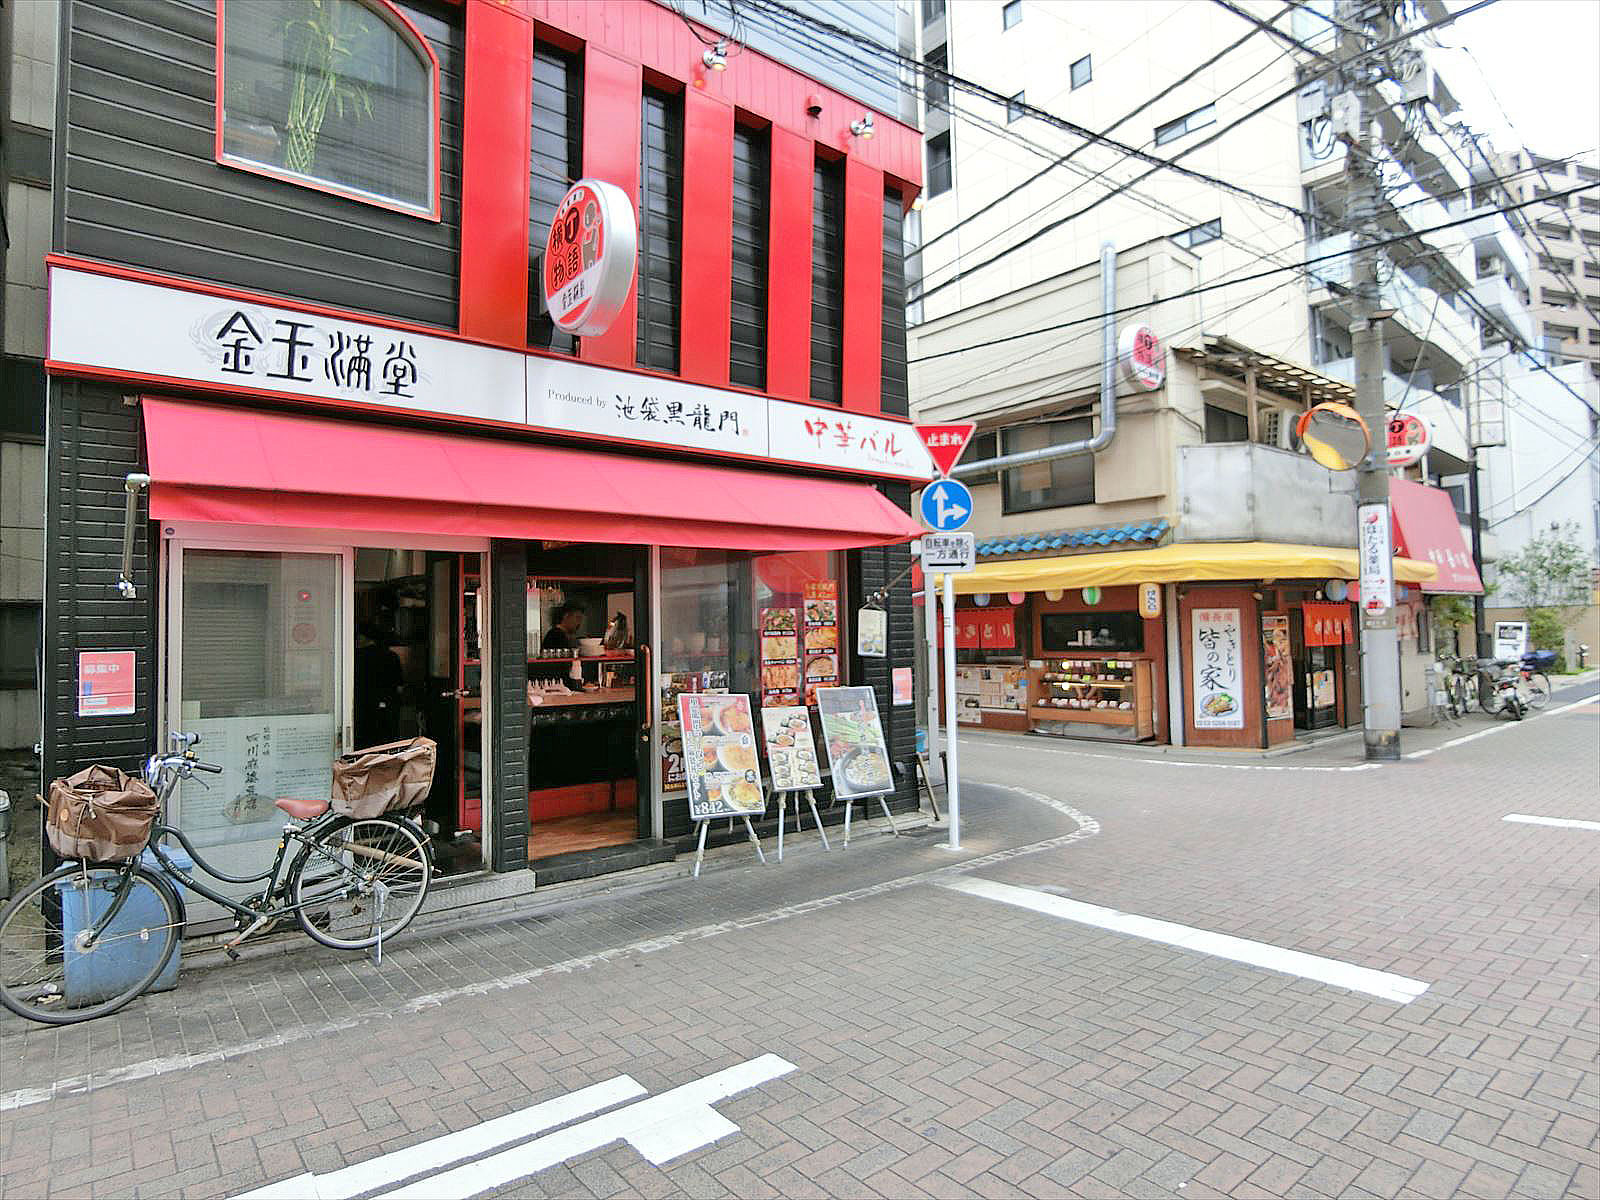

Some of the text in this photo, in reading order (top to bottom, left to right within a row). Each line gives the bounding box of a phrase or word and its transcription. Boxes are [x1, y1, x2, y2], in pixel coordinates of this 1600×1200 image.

[216, 311, 418, 398] 金玉満堂
[547, 388, 608, 409] Produced by
[615, 393, 740, 436] 池袋黒龍門
[805, 416, 903, 457] 中華バル
[927, 431, 964, 447] 止まれ
[925, 537, 969, 550] 自転車を除く
[926, 550, 969, 560] 一方通行
[1199, 627, 1230, 691] 皆の家
[1224, 624, 1237, 682] やきとり
